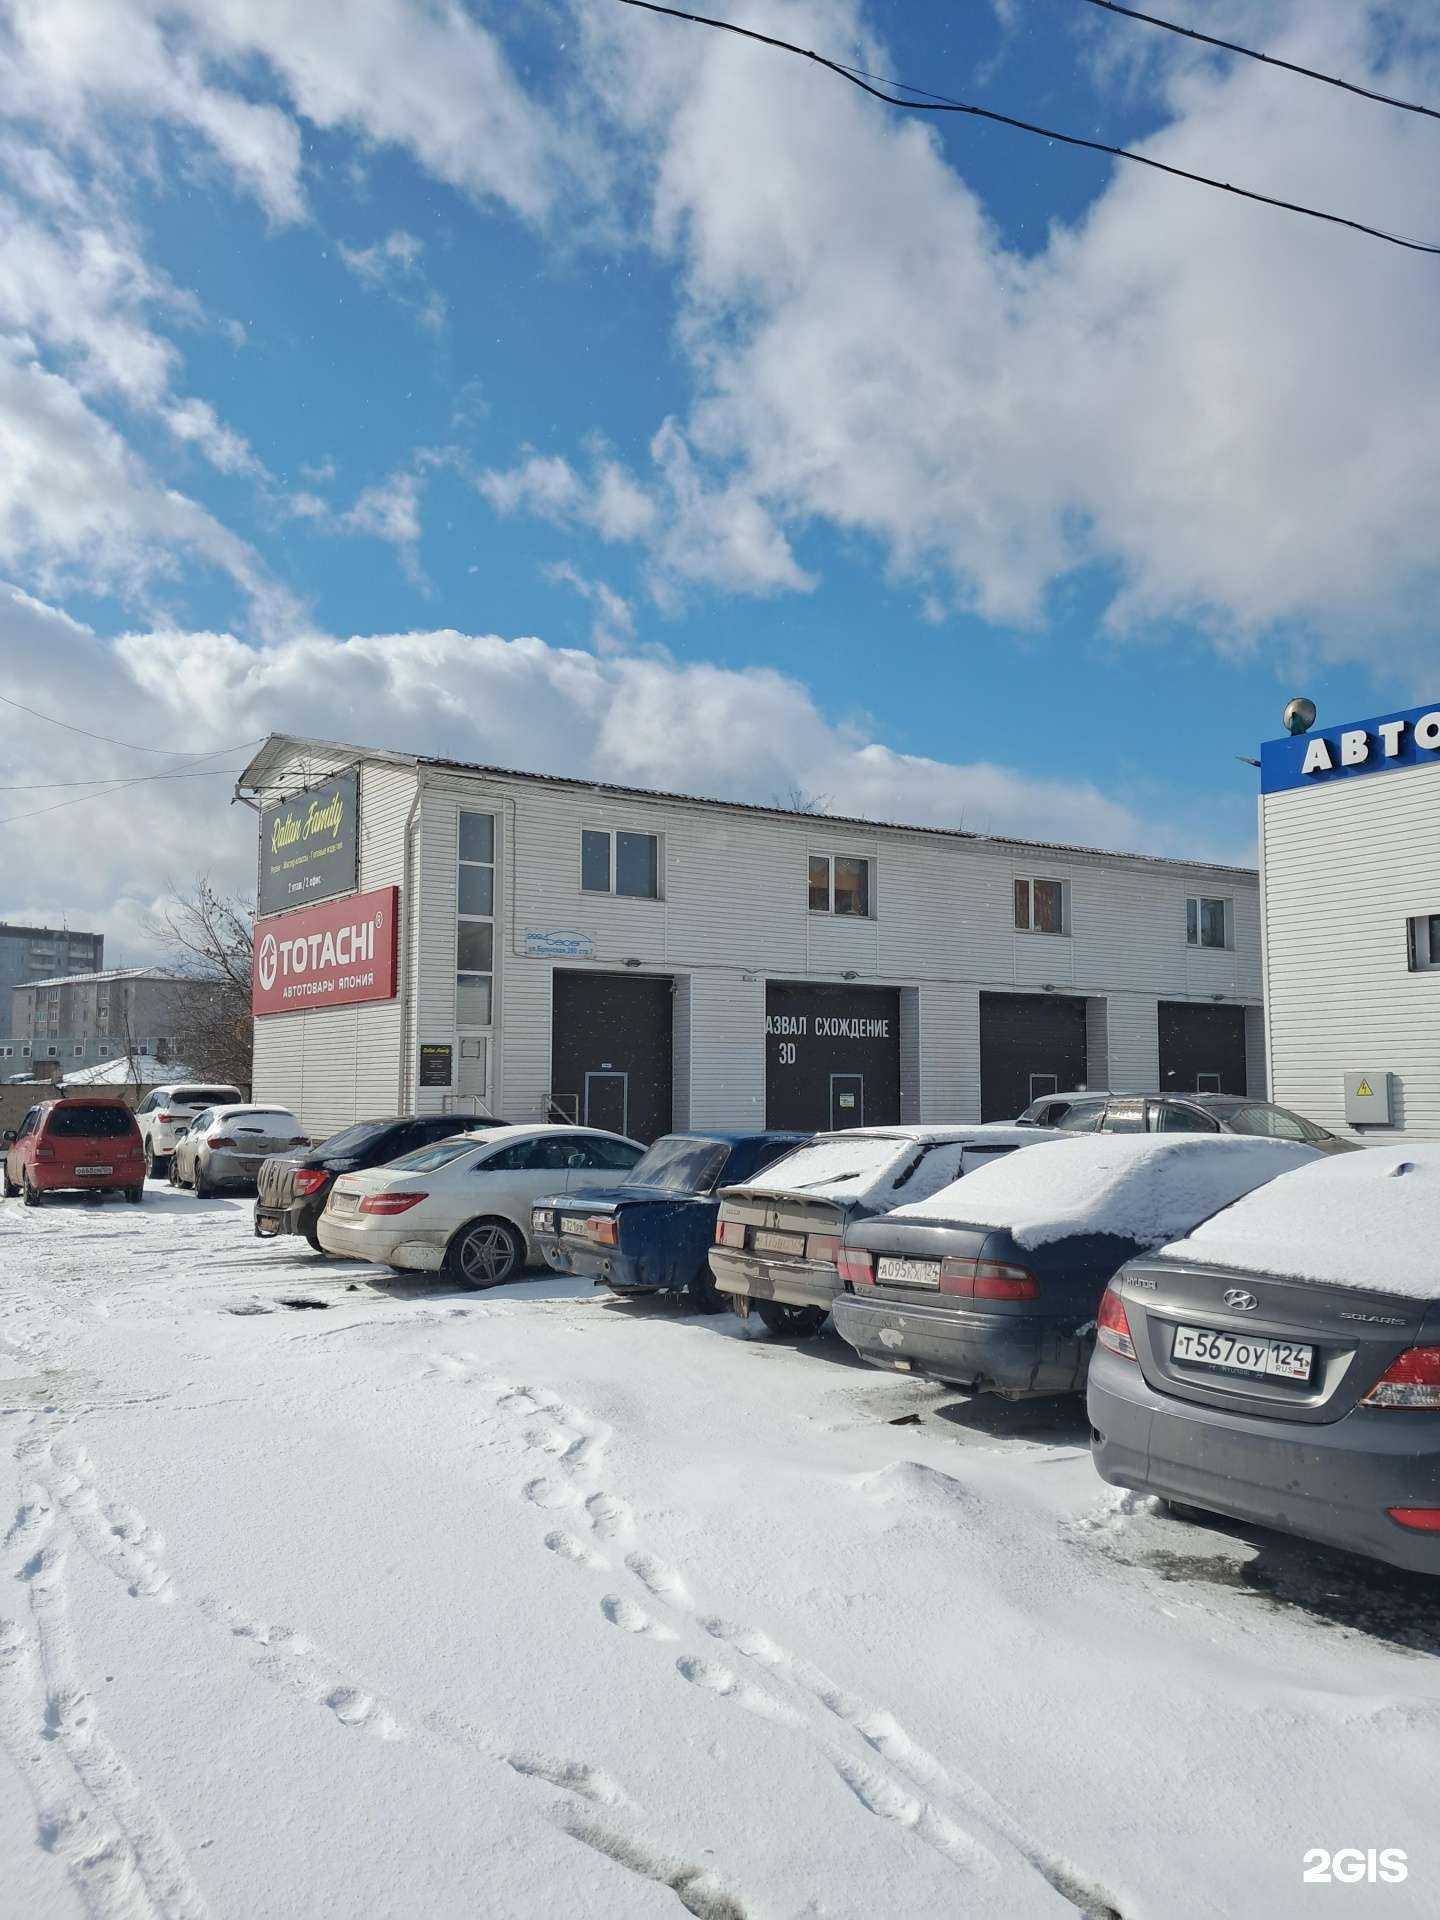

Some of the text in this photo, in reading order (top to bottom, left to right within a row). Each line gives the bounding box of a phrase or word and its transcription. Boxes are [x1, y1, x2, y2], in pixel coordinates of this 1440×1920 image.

[1301, 711, 1440, 774] АВТО
[302, 792, 343, 840] Family
[279, 920, 375, 976] TOTACHI
[282, 971, 374, 1000] АВТОТОВАРЫ ЯПОНИЯ
[765, 1015, 889, 1039] АЗВАЛ СХОЖДЕНИЕ
[778, 1042, 796, 1065] 3D
[1339, 1312, 1408, 1326] SOLARIS
[1271, 1344, 1305, 1368] 124
[1275, 1365, 1294, 1374] RUS
